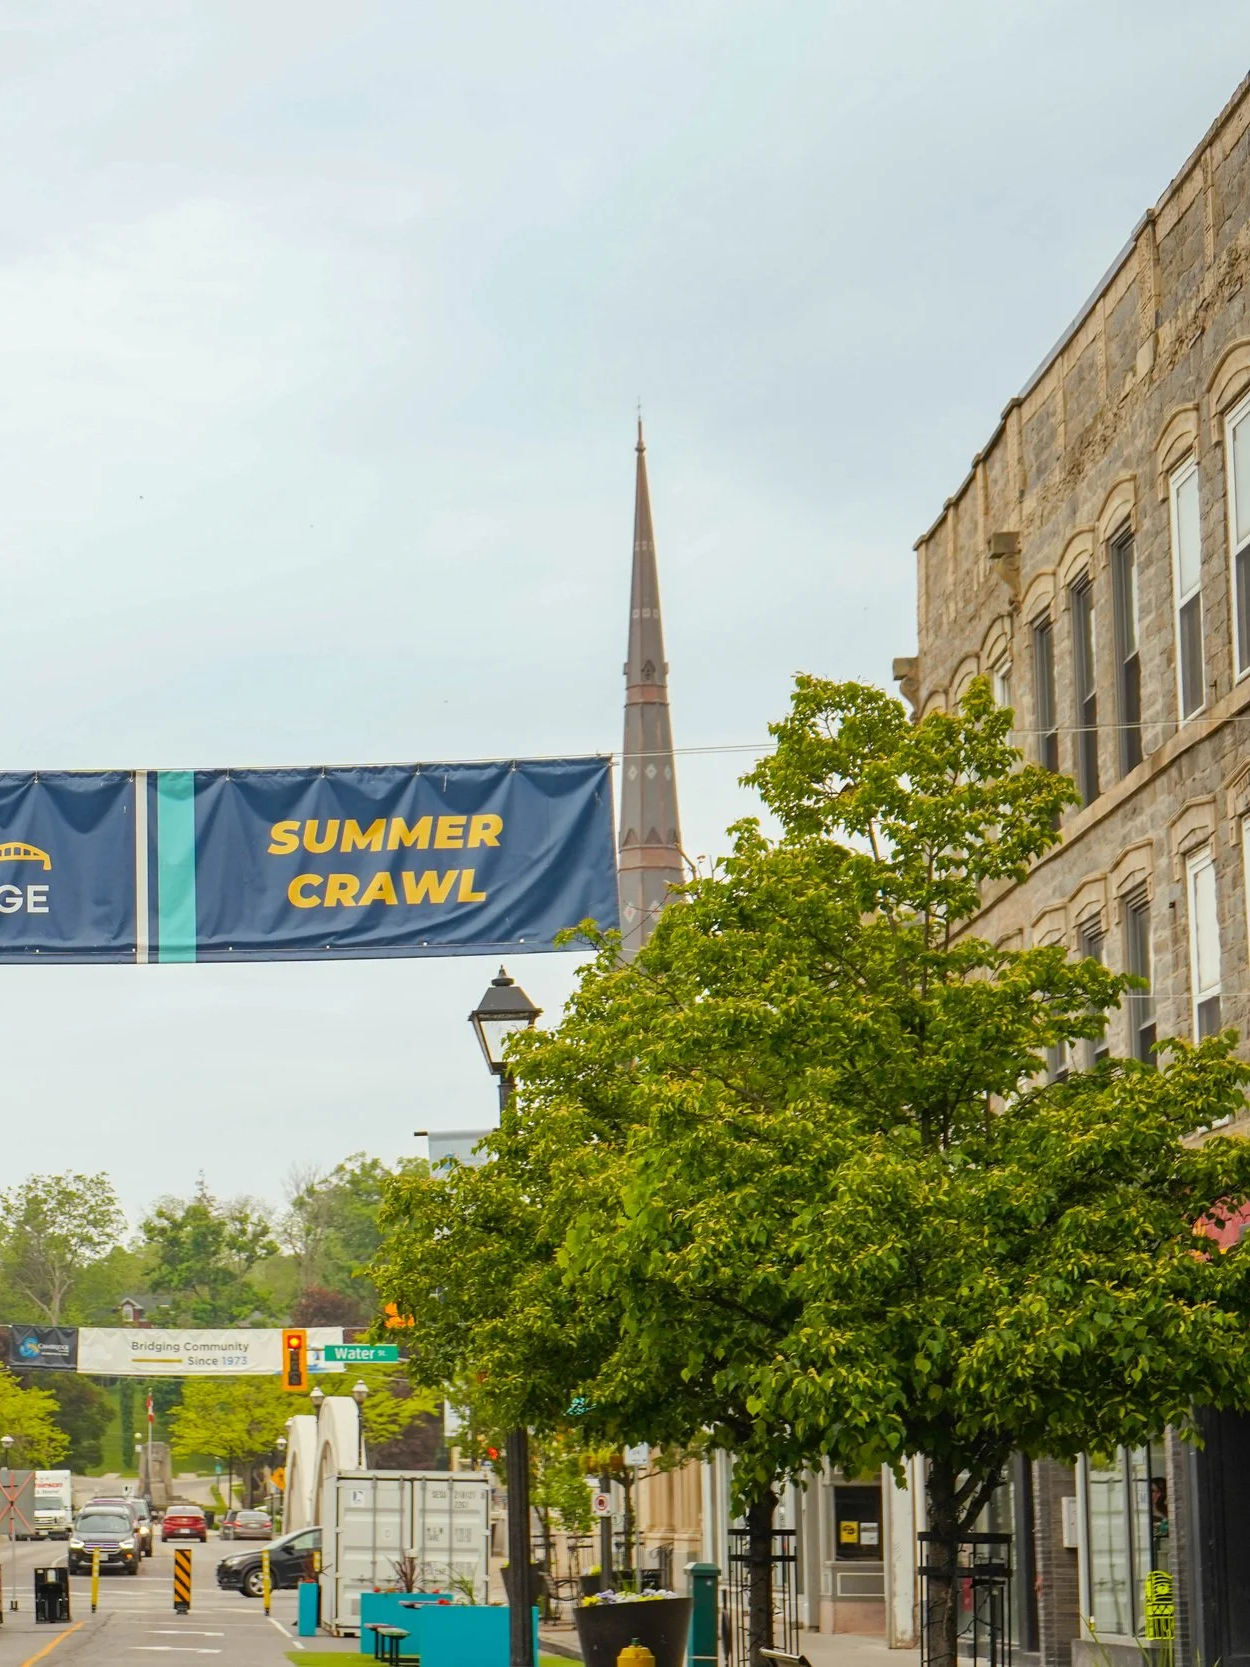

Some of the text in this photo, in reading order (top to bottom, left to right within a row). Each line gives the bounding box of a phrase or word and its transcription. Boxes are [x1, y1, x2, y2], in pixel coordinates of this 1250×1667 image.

[267, 813, 504, 855] SUMMER
[287, 868, 487, 909] CRAWL
[131, 1341, 250, 1353] Bridging Community
[334, 1347, 376, 1360] Water
[188, 1356, 248, 1366] Since 1973
